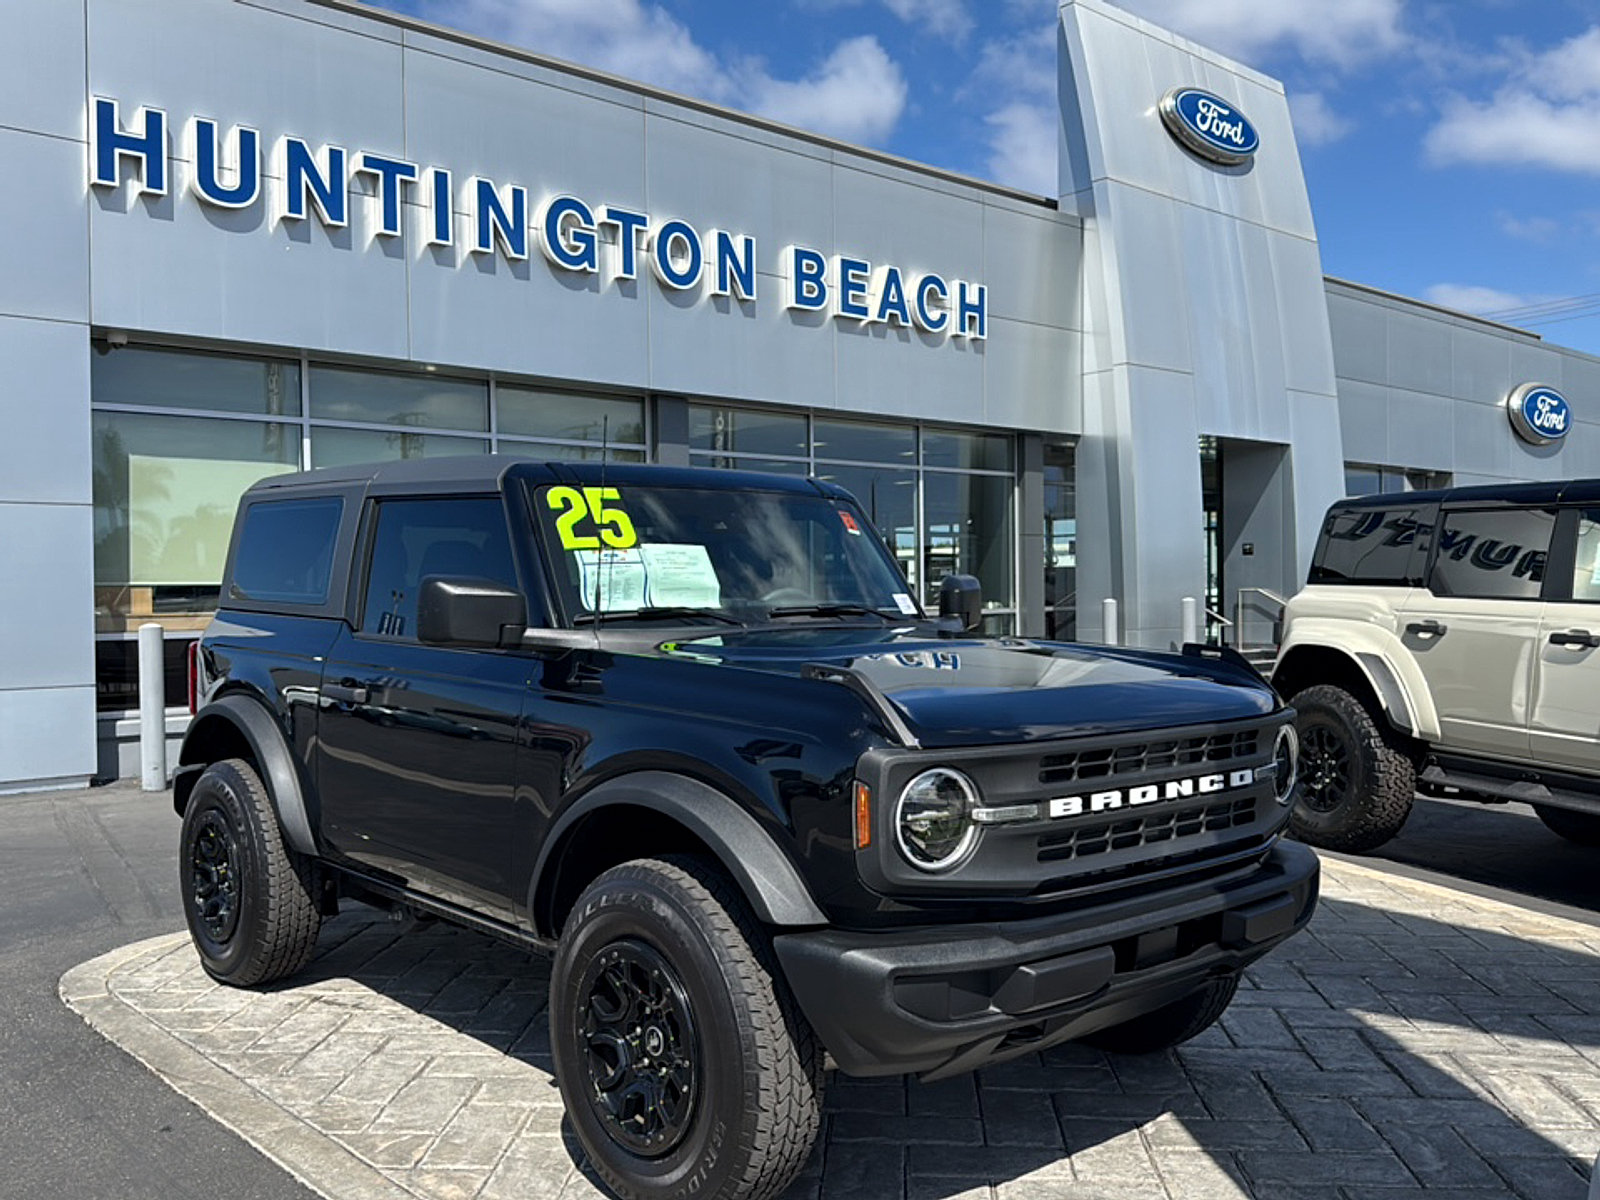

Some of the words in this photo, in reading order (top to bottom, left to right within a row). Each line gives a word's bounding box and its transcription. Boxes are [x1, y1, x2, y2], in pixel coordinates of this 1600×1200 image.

[1196, 98, 1245, 145] Ford
[92, 96, 757, 301] HUNTINGTON
[789, 245, 988, 340] BEACH
[1533, 395, 1567, 431] Ford
[546, 486, 637, 550] 25
[1049, 768, 1253, 819] BRONCO
